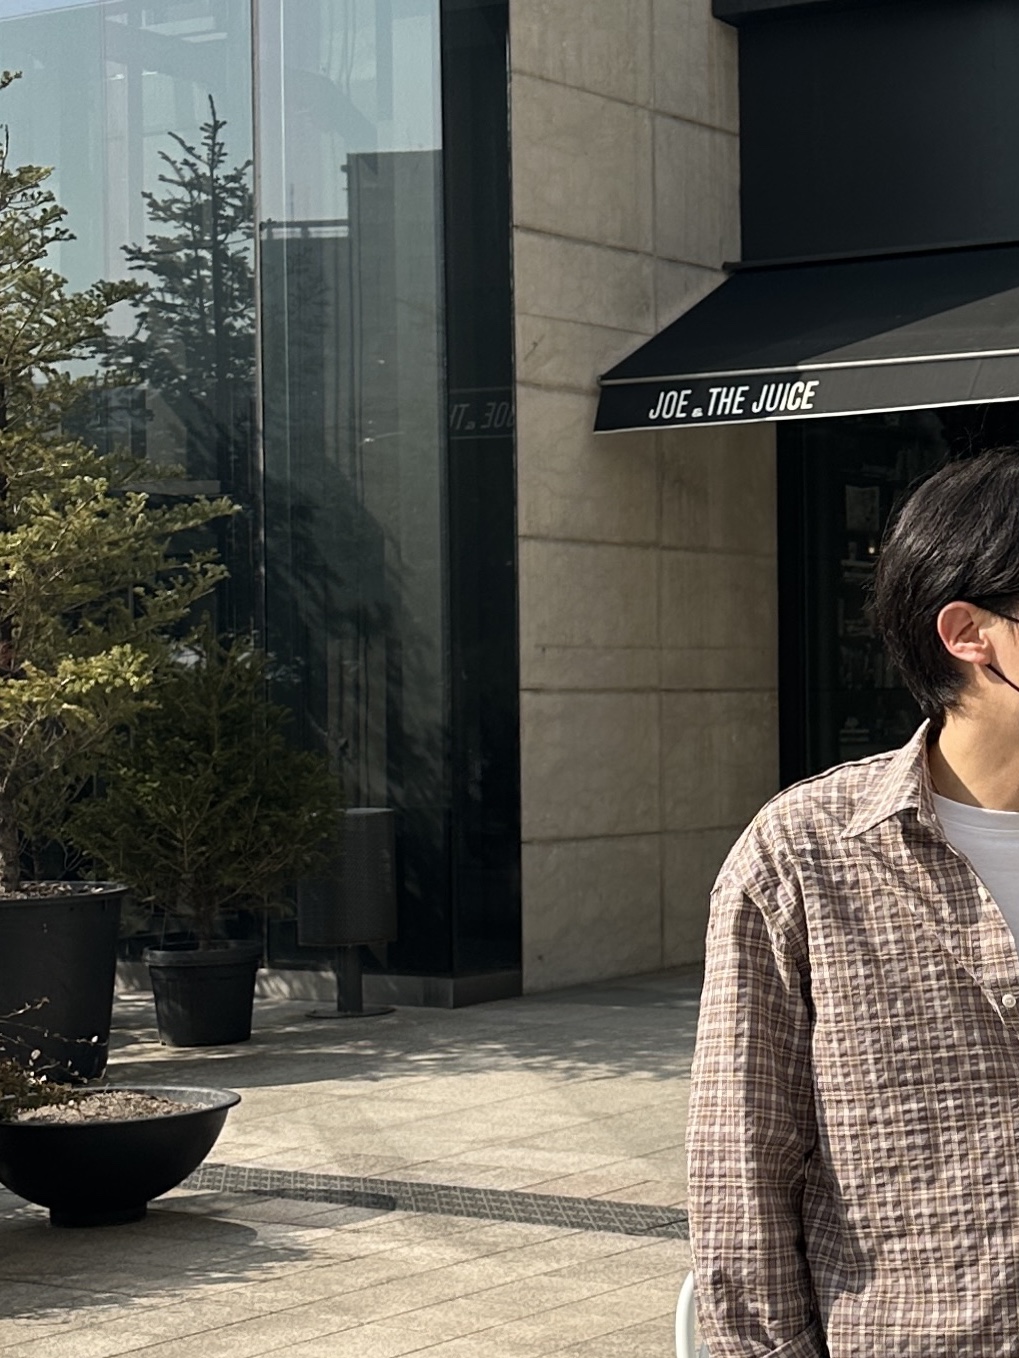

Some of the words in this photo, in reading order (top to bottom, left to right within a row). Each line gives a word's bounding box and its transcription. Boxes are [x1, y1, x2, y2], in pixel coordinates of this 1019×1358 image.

[648, 389, 693, 419] JOE
[707, 385, 750, 416] THE
[751, 380, 820, 413] JUICE
